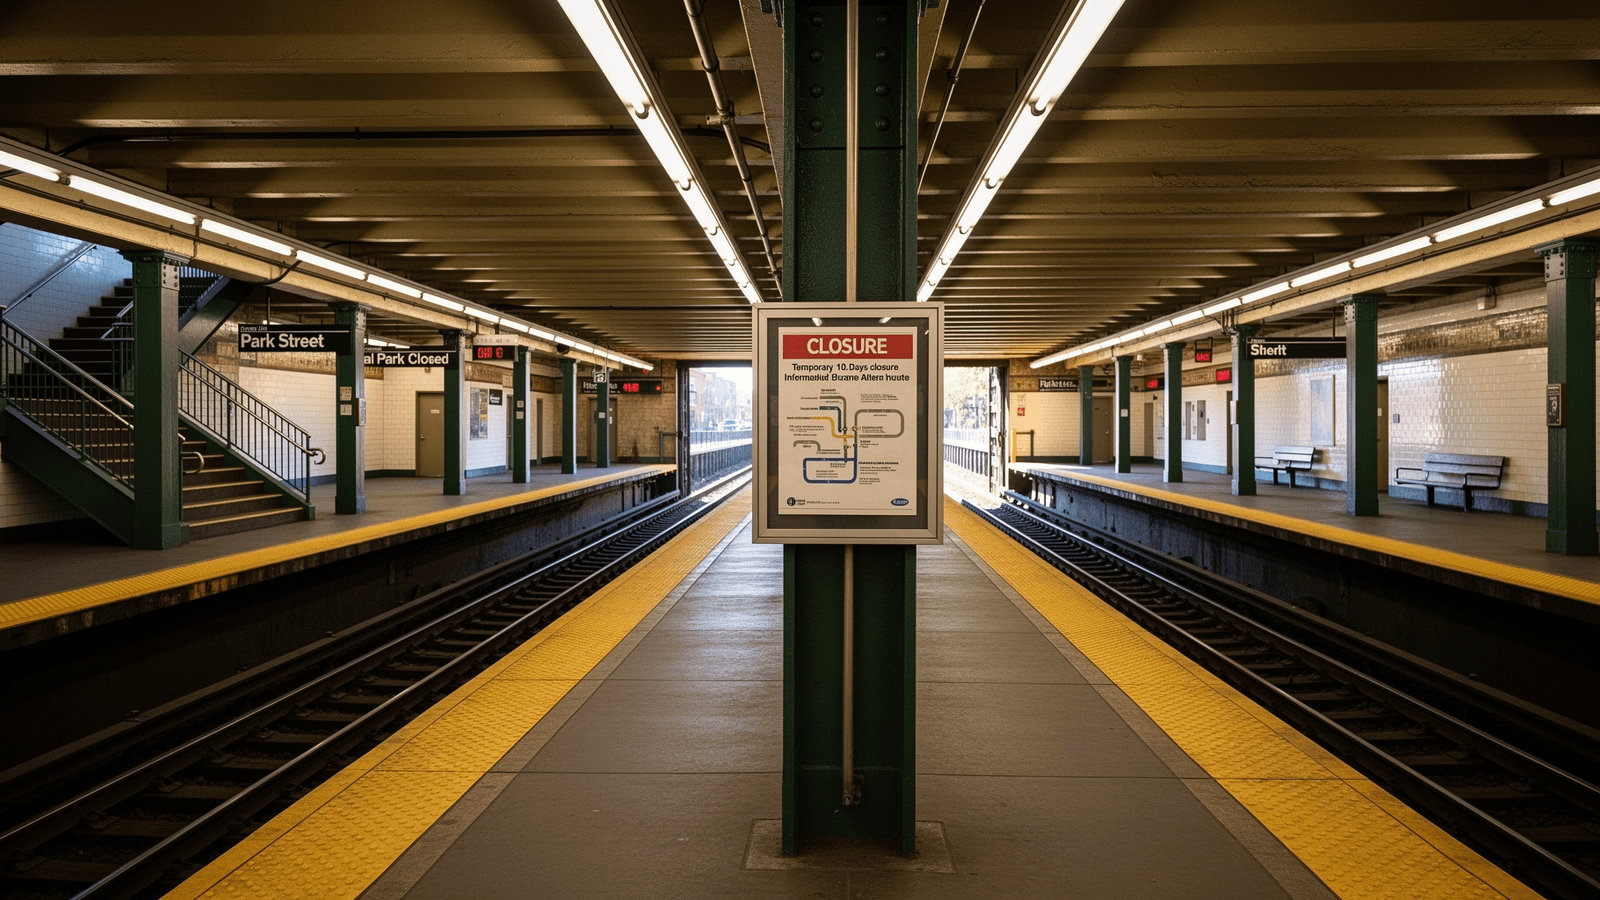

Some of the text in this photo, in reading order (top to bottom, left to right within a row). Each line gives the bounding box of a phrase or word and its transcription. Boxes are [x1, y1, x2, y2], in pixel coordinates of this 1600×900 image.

[241, 333, 324, 348] Park Street
[806, 337, 888, 354] CLOSURE
[363, 352, 449, 365] al Park Closed
[792, 363, 833, 373] Temporary
[869, 362, 899, 371] closure
